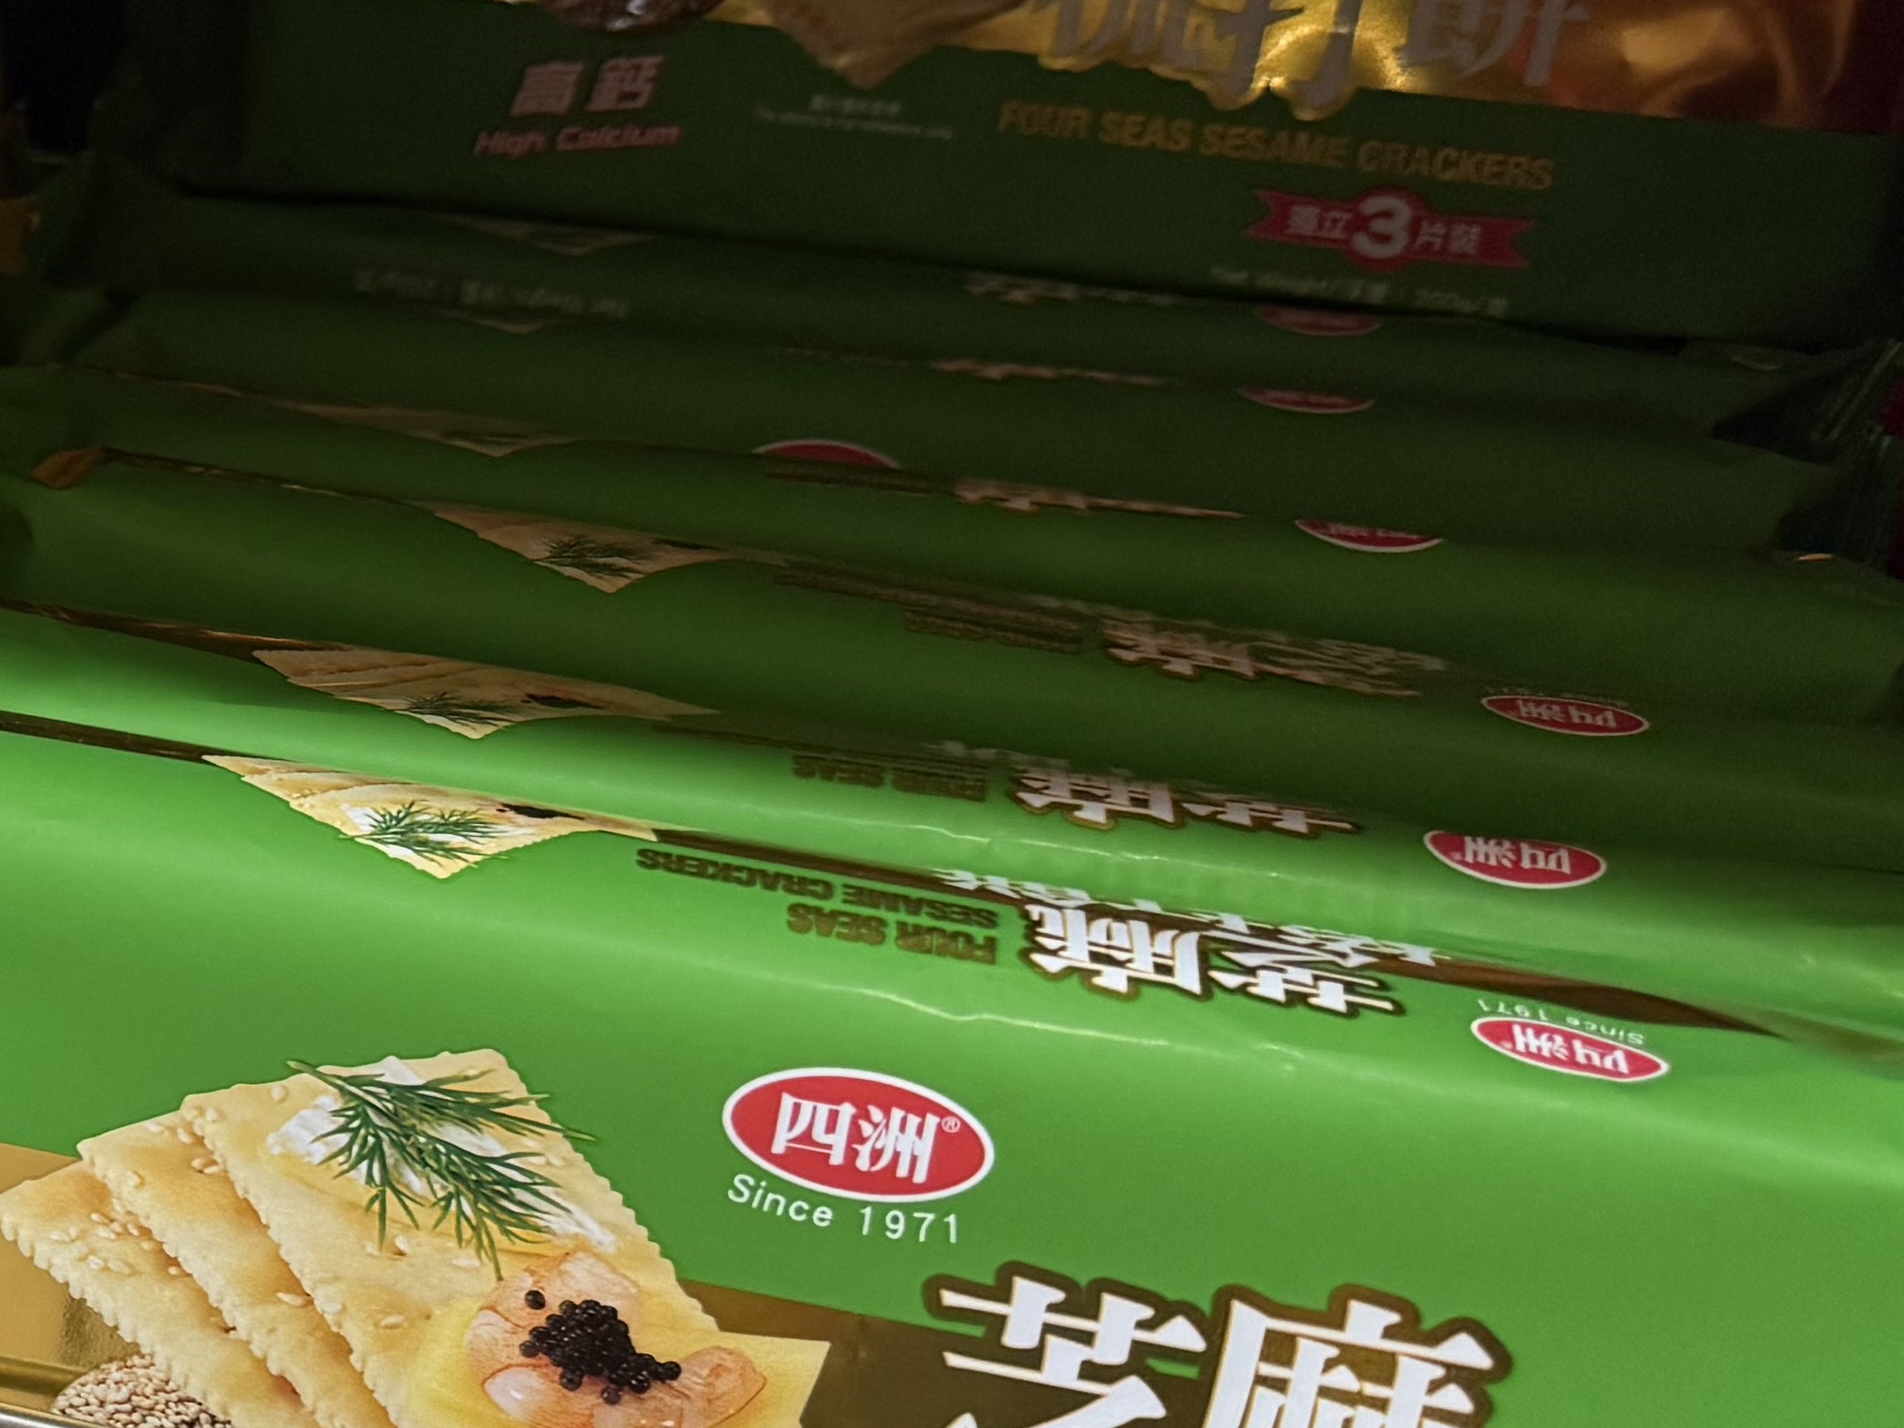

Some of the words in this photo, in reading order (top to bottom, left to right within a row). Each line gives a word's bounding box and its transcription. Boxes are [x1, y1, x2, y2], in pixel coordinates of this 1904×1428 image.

[998, 99, 1091, 140] FOUR
[1098, 110, 1191, 152] SEAS
[1199, 122, 1352, 169] SESAME
[1357, 139, 1554, 191] CRACKERS
[635, 847, 835, 902] CRACKERS
[787, 901, 887, 947] SEAS
[841, 883, 1001, 929] SESAME
[895, 920, 998, 965] FOUR
[1510, 1023, 1630, 1075] 四洲
[1566, 1014, 1646, 1047] Since
[768, 1090, 942, 1185] 四洲
[726, 1172, 834, 1228] Since
[857, 1203, 960, 1245] 1971
